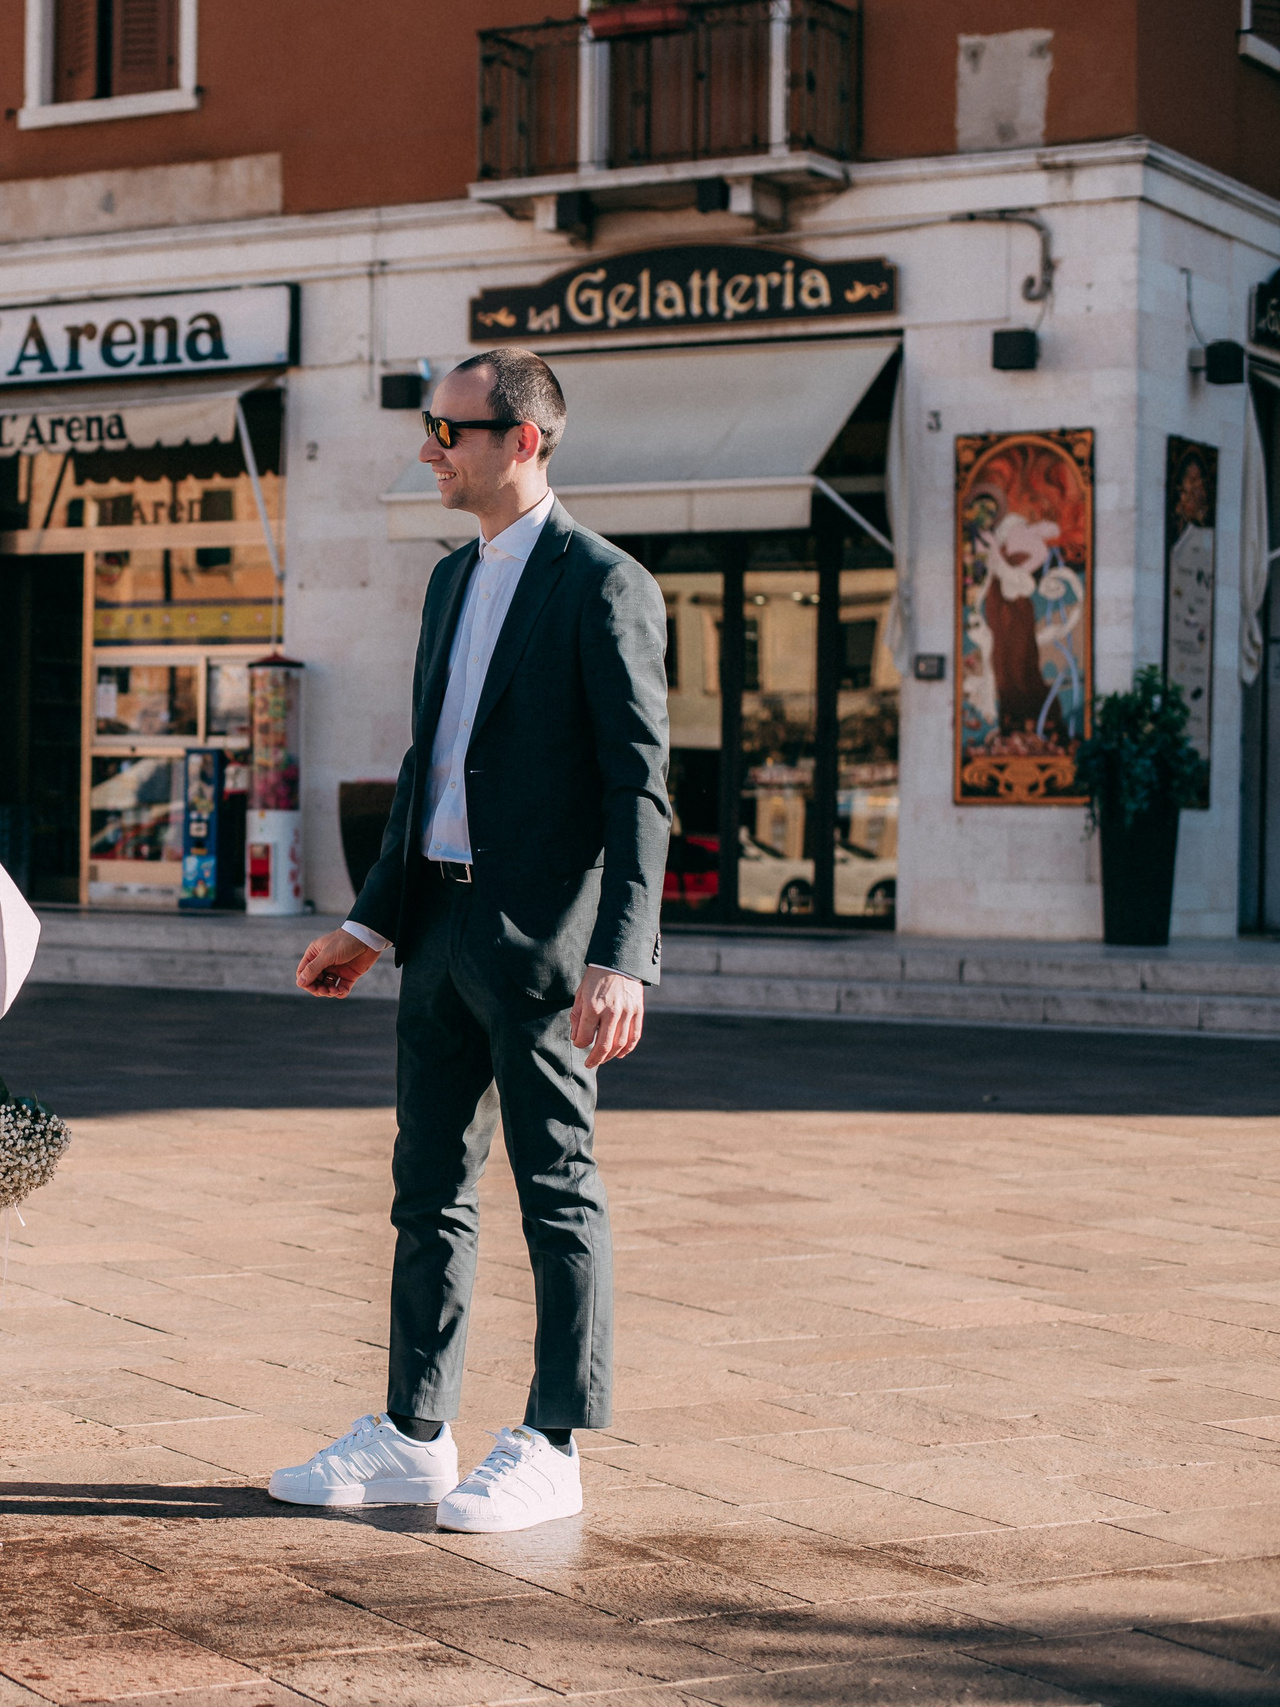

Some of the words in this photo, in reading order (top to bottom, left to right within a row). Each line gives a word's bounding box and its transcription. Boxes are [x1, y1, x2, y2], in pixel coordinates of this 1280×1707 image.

[565, 259, 833, 328] Gelatteria
[926, 410, 942, 432] 3
[306, 441, 319, 461] 2
